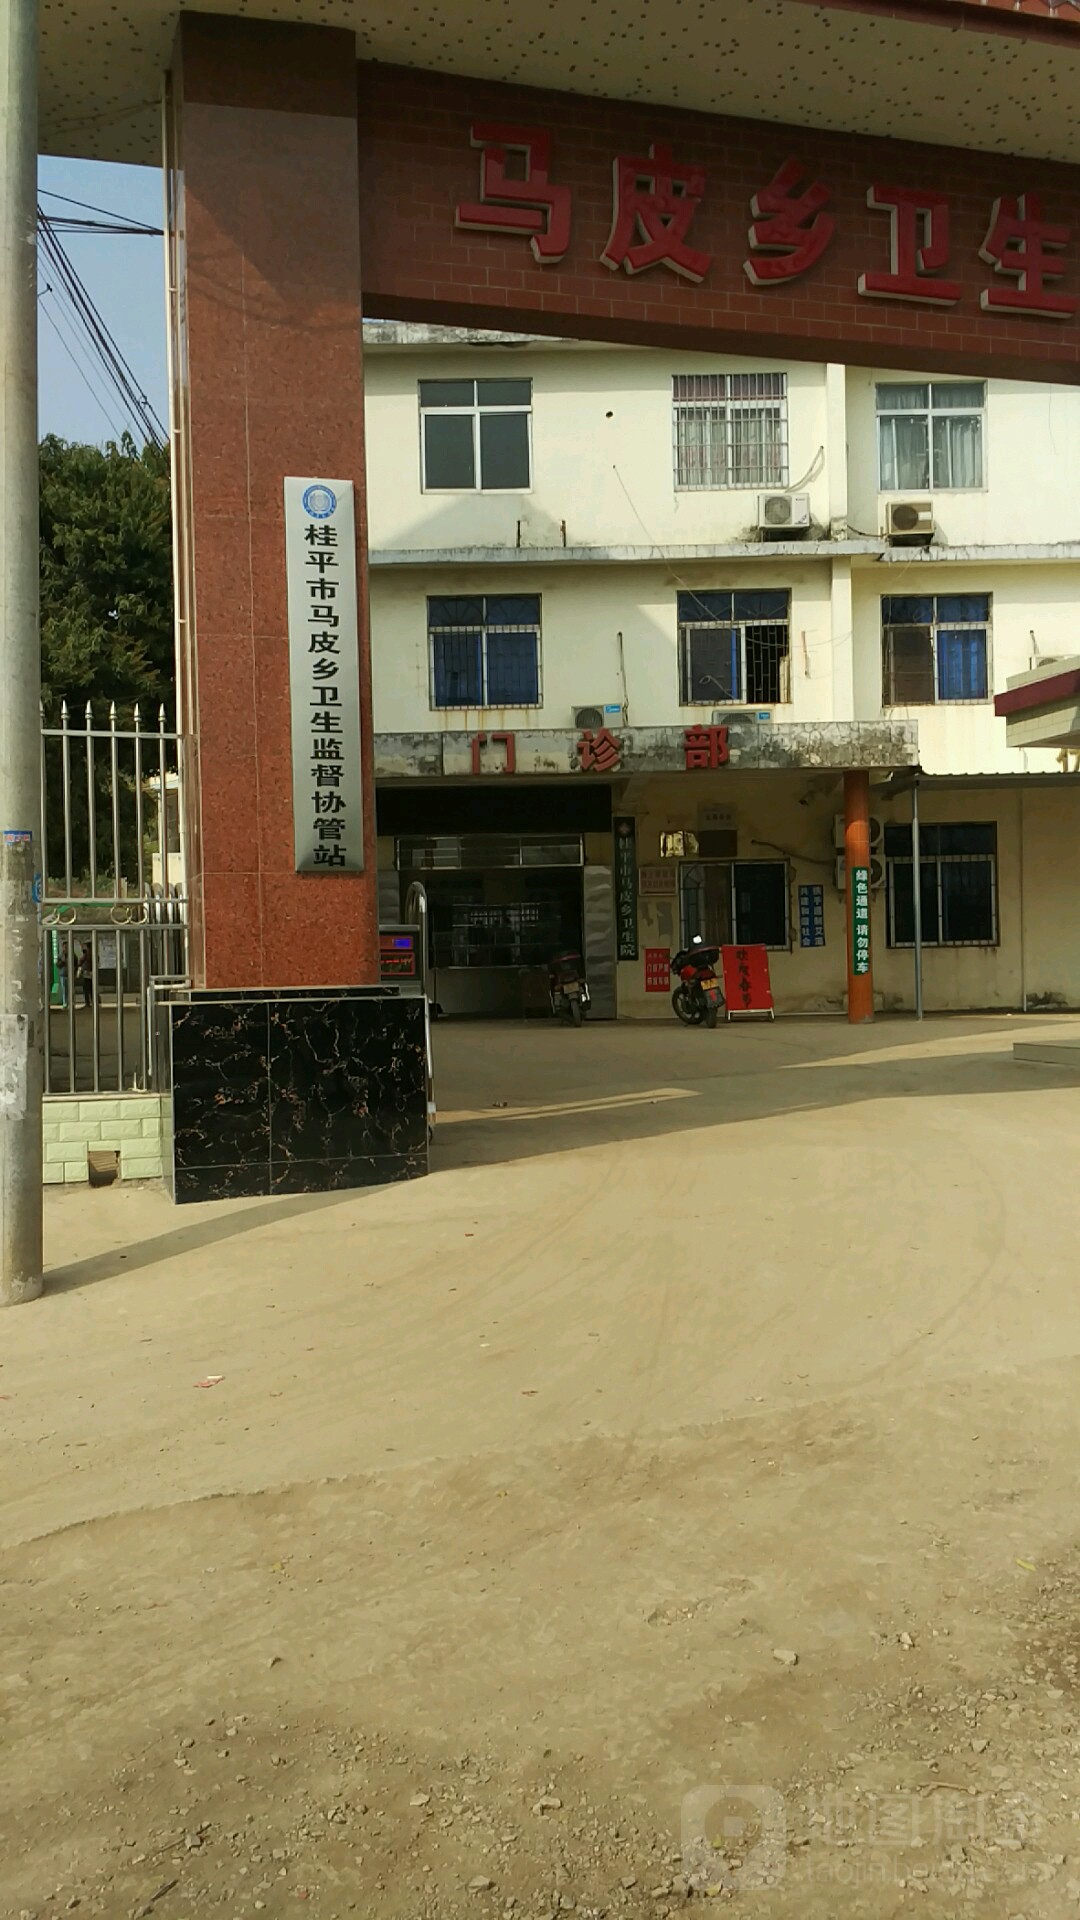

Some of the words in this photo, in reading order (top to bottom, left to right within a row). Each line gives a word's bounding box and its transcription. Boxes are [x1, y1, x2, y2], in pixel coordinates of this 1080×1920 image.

[455, 123, 1077, 319] 马皮乡卫生
[304, 524, 347, 866] 桂平市马皮乡卫生监督协管站
[471, 723, 729, 776] 门诊部
[618, 836, 636, 957] 桂平市马皮乡卫生院
[855, 869, 868, 920] 绿色通道
[856, 923, 869, 974] 请勿停车
